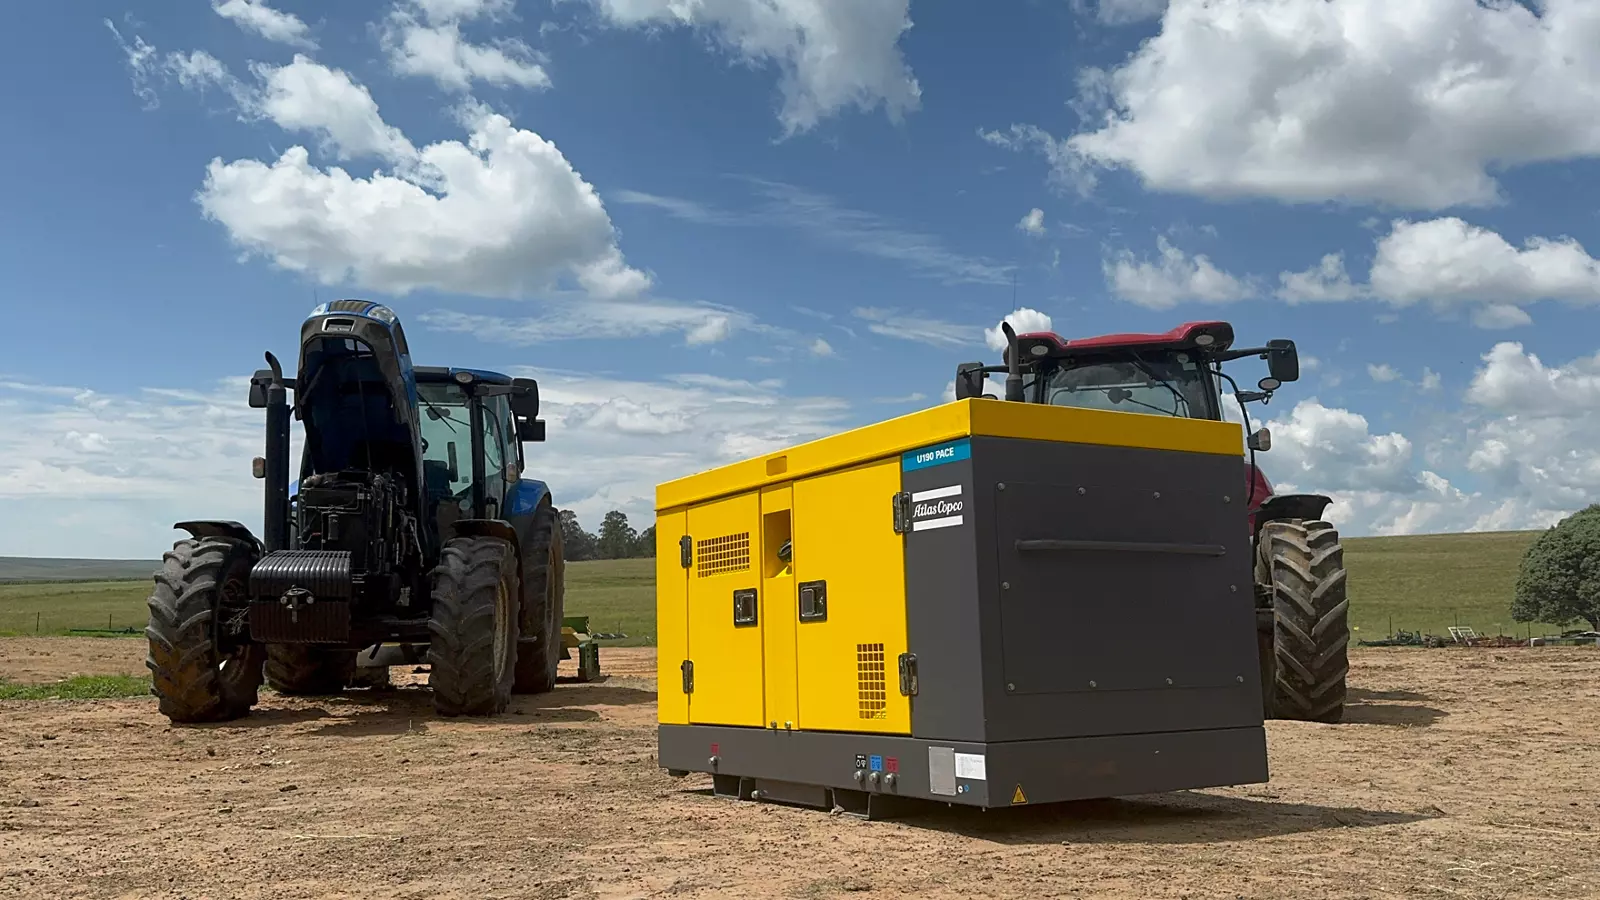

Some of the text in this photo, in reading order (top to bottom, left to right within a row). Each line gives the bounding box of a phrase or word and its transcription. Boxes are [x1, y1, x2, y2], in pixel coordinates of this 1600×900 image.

[916, 447, 954, 463] U190 PACE
[913, 500, 962, 517] Atlas Copco
